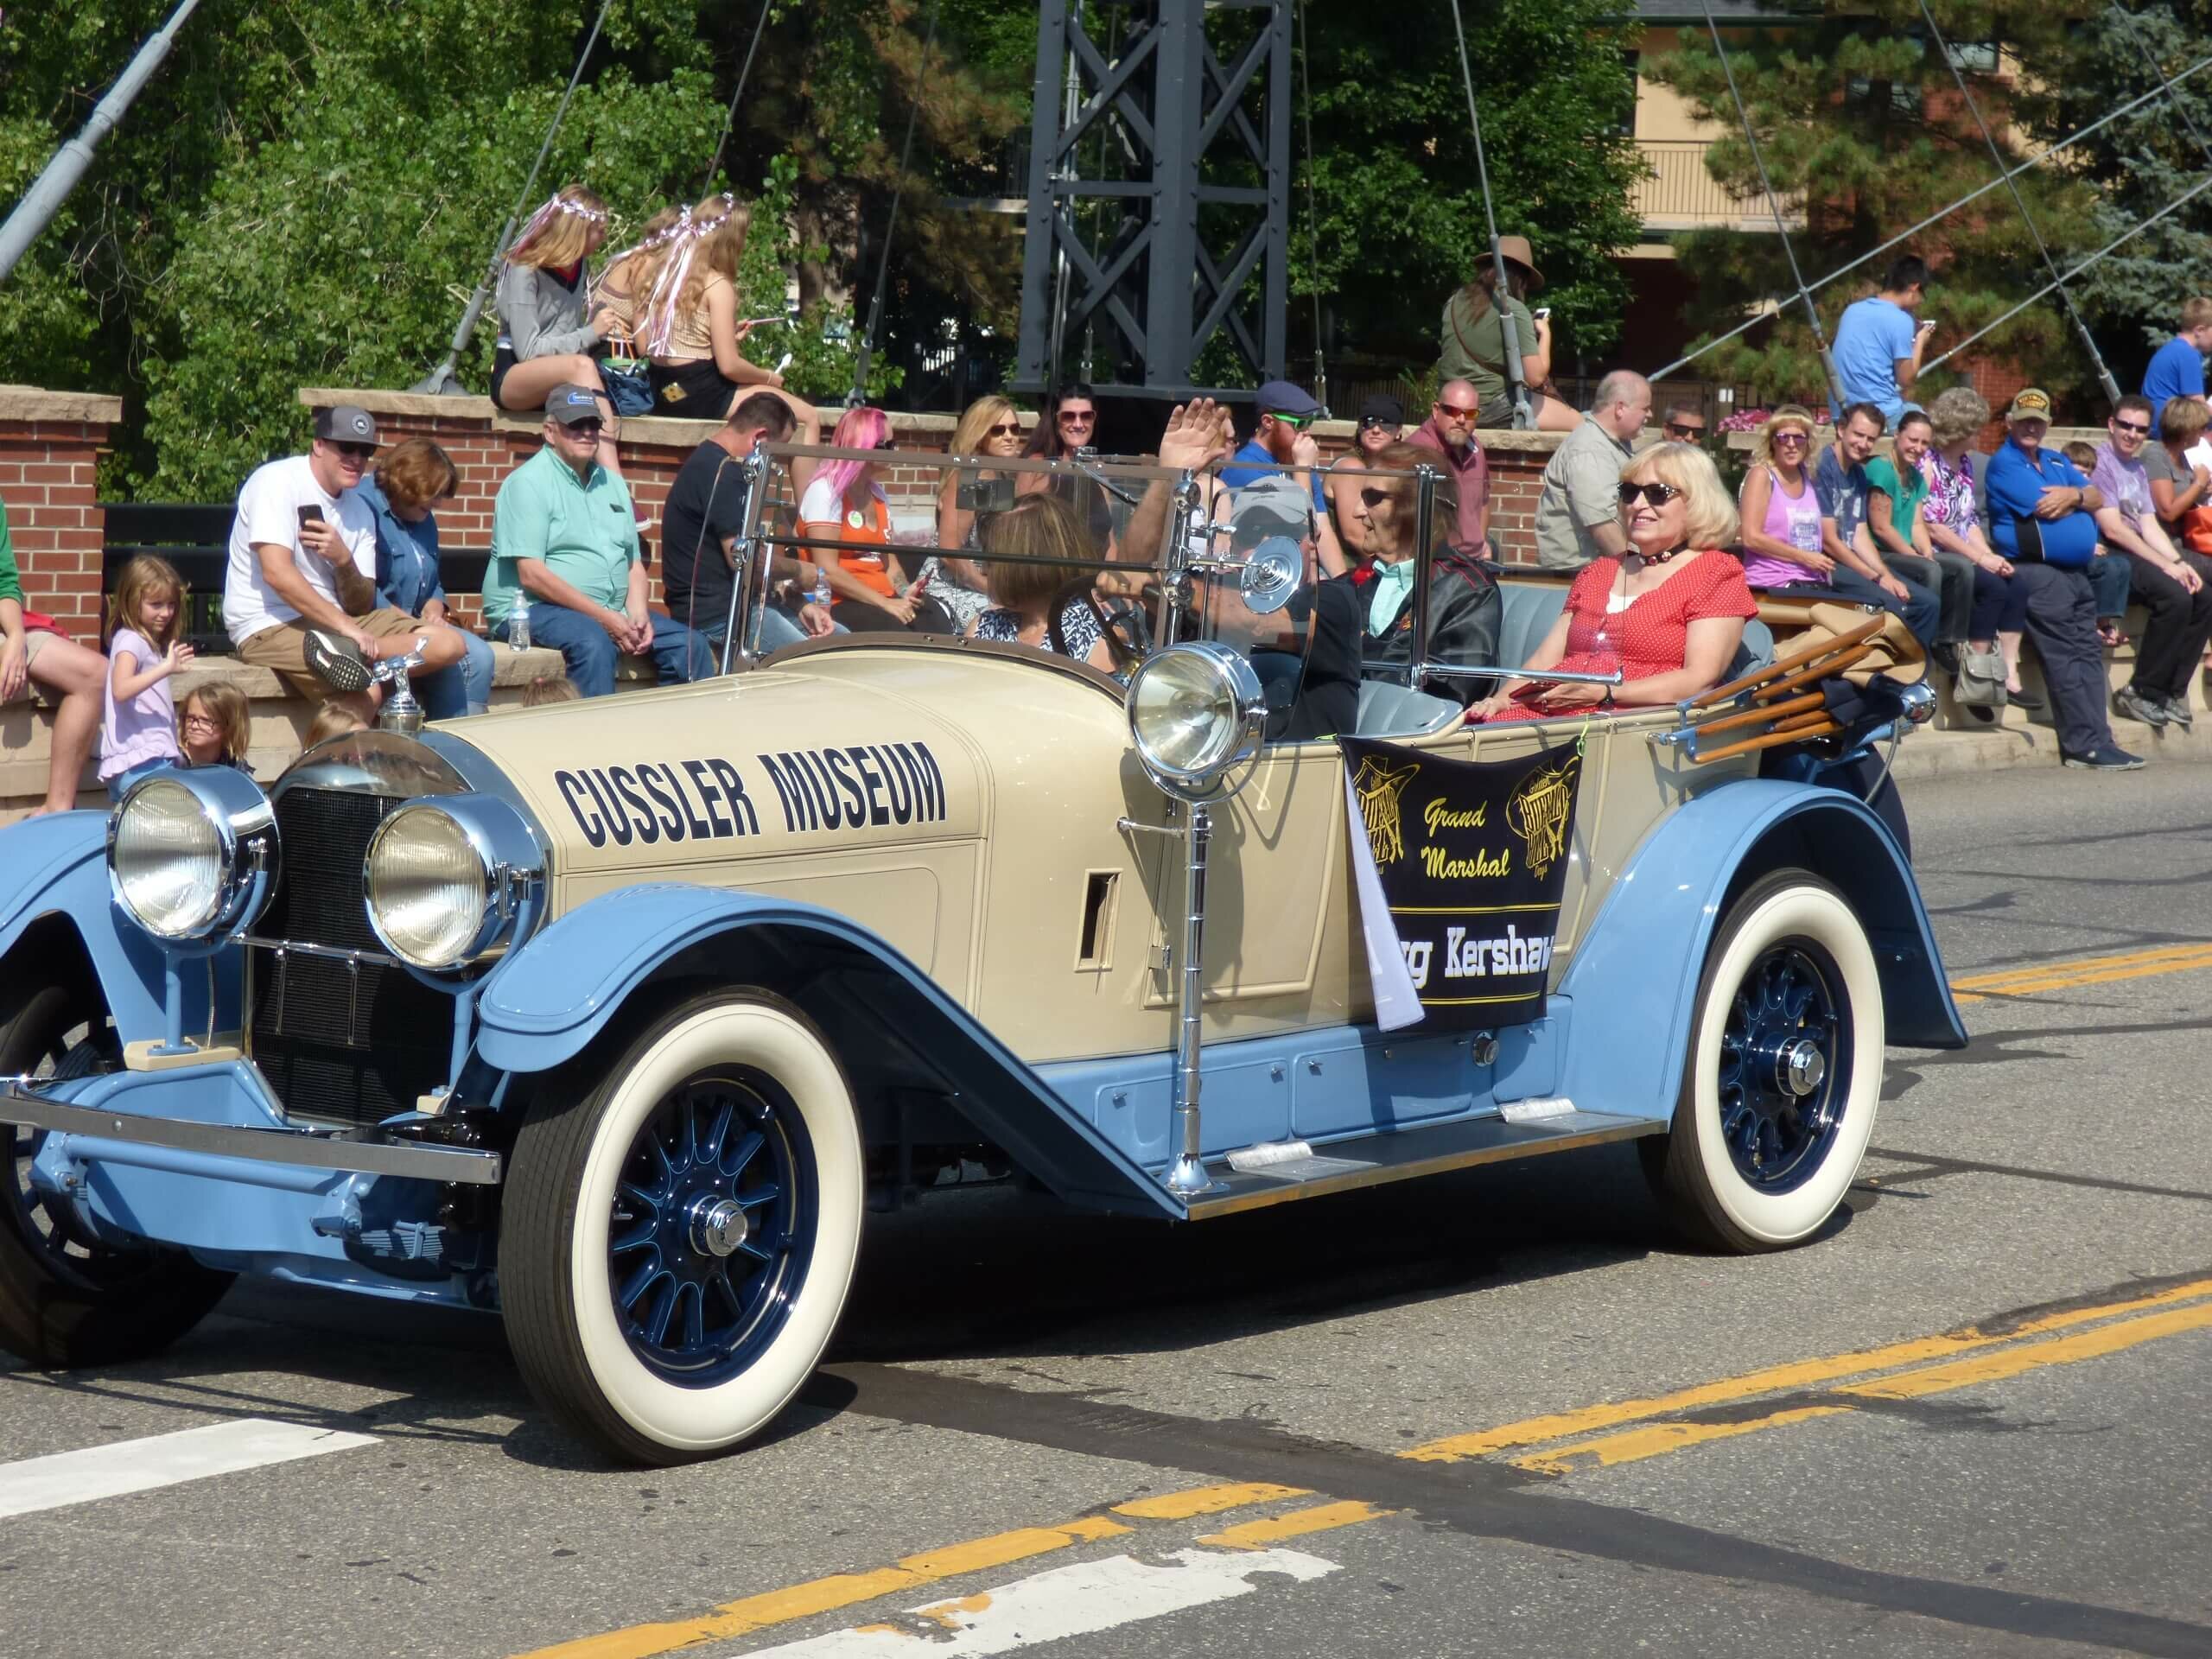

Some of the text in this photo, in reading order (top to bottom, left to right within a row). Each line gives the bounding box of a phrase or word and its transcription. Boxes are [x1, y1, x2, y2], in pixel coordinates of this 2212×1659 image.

[554, 741, 946, 848] CUSSLER MUSEUM
[1425, 798, 1487, 836] Grand
[1421, 846, 1510, 879] Marshal
